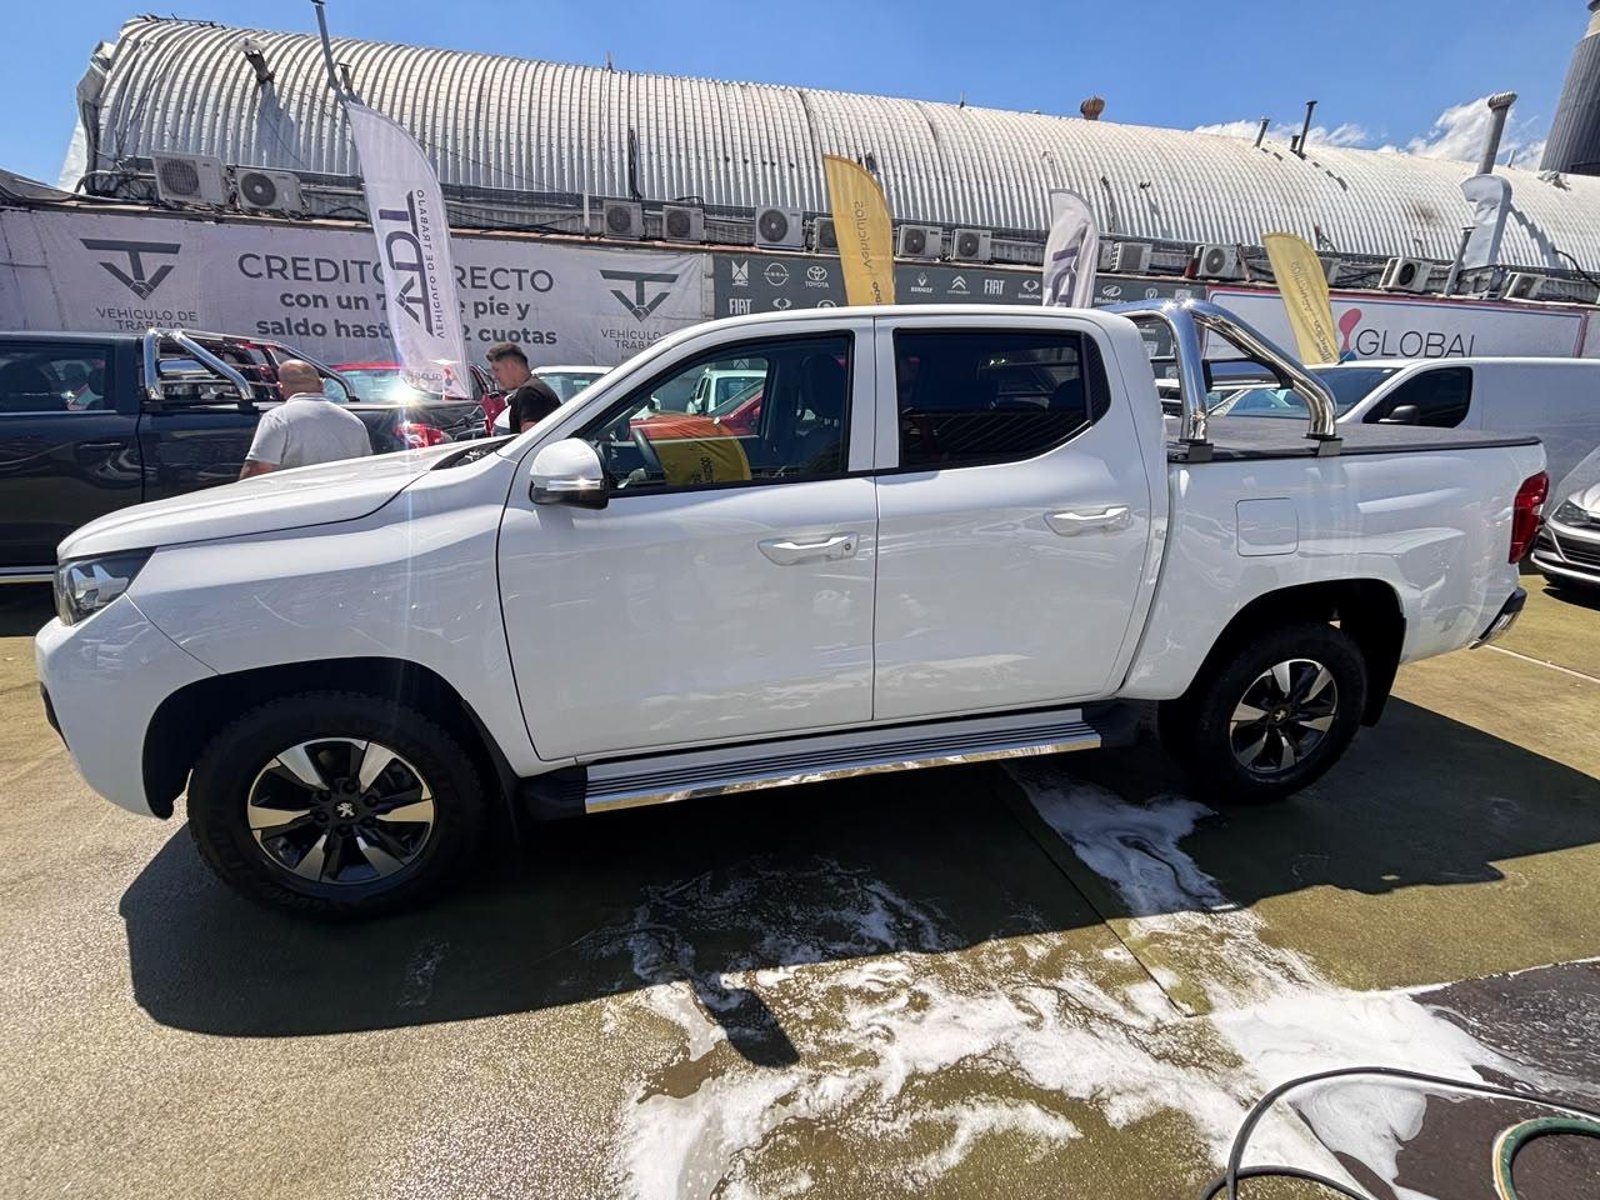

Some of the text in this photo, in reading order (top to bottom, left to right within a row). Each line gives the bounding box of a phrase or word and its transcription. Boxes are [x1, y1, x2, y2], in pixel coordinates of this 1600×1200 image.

[454, 265, 554, 293] RECTO
[805, 280, 830, 289] TOYOTA
[984, 279, 1006, 295] FIAT
[280, 292, 329, 309] con
[336, 295, 370, 311] un
[473, 296, 510, 319] pie
[516, 303, 530, 321] y
[728, 298, 753, 315] FIAT
[177, 310, 199, 322] DE
[256, 316, 328, 338] saldo
[334, 319, 393, 340] hast
[478, 328, 557, 345] cuotas
[615, 339, 652, 350] TRAB
